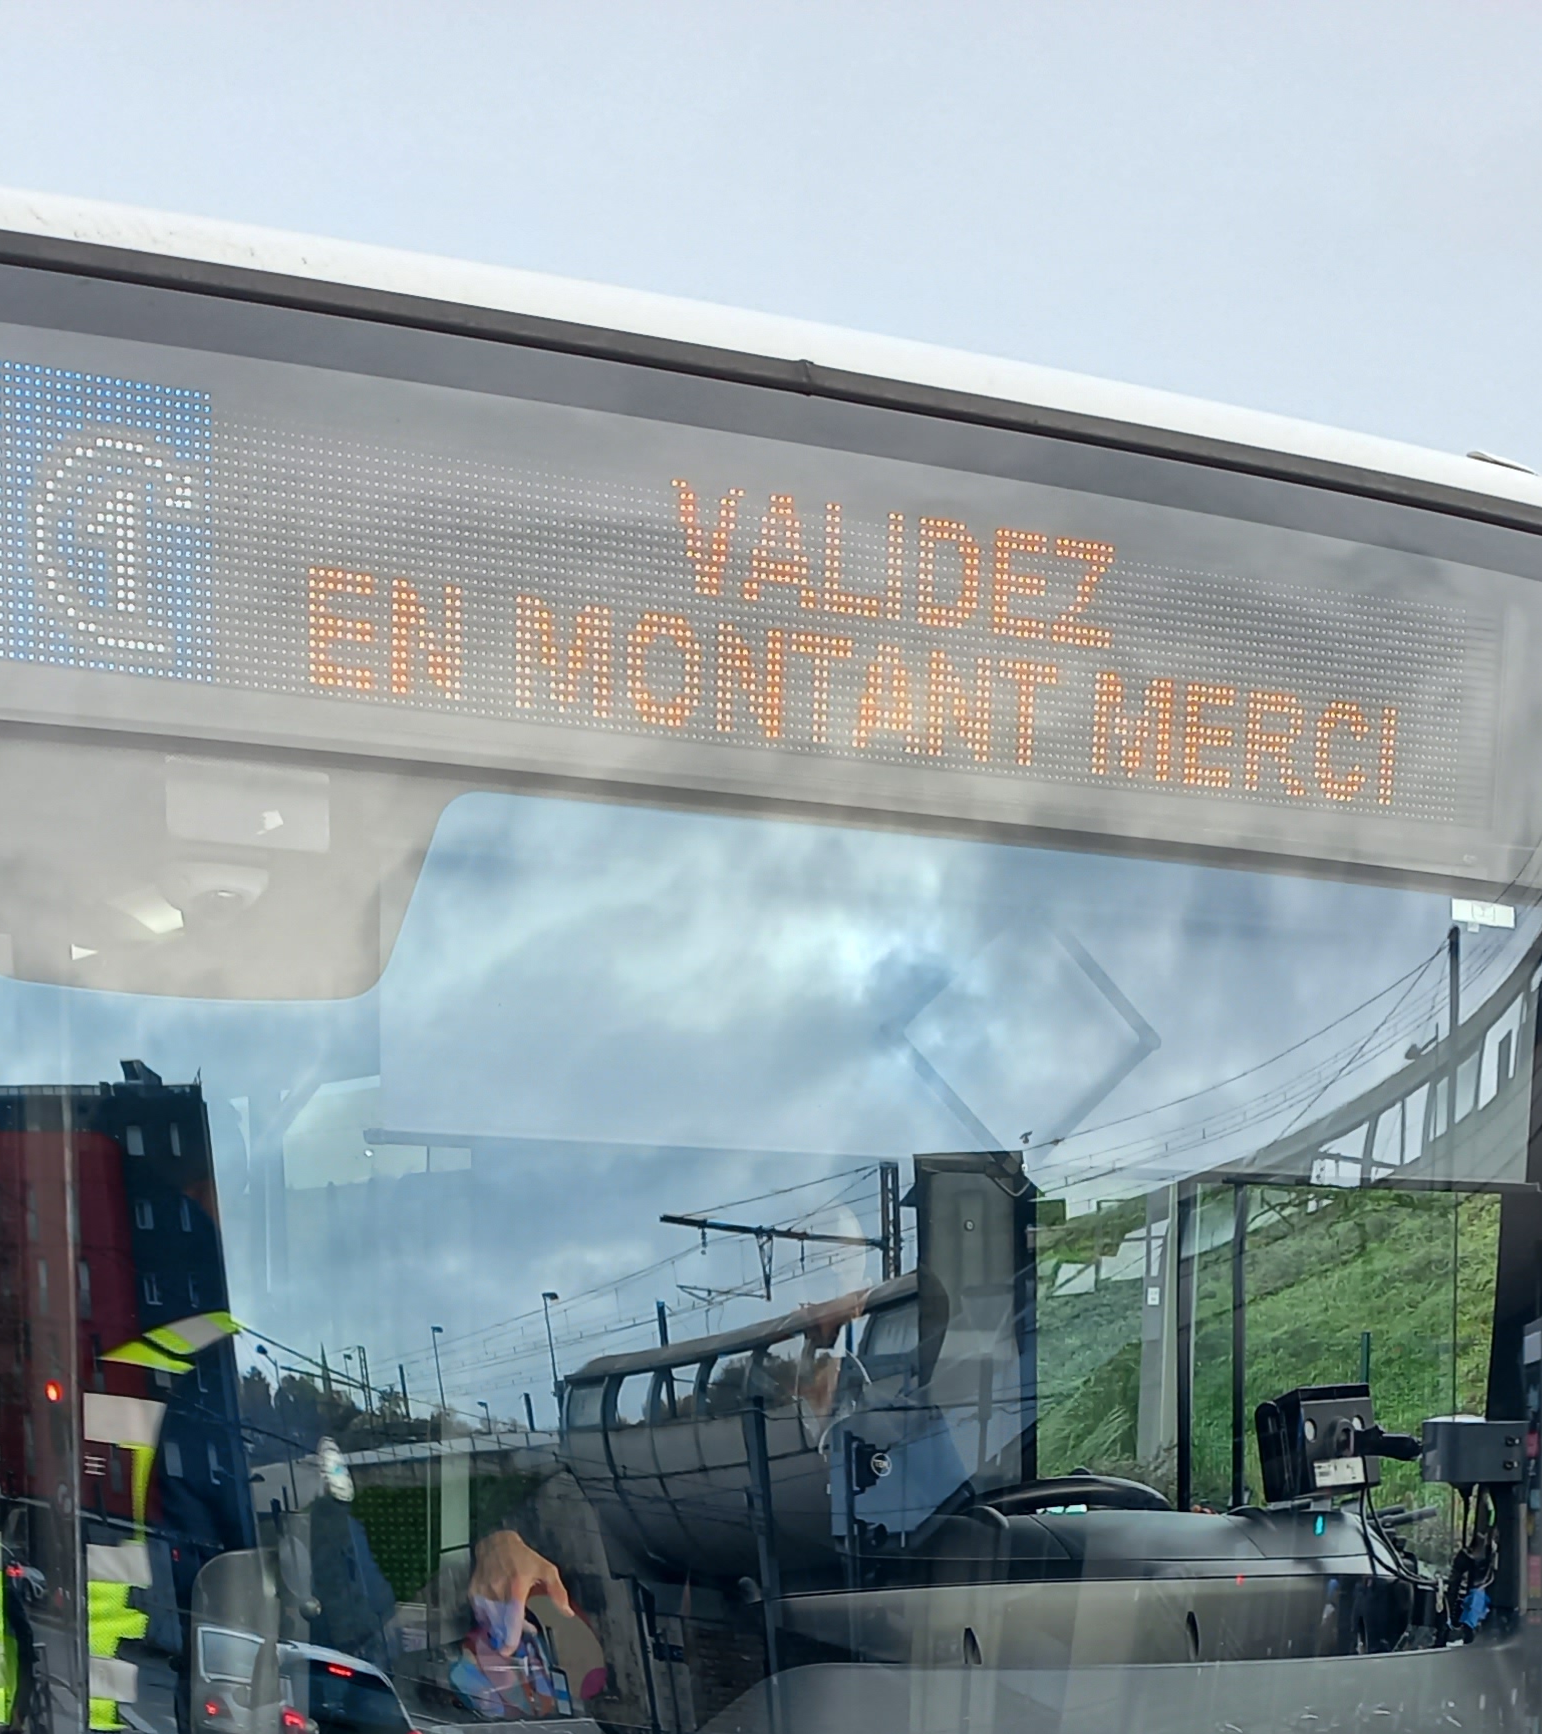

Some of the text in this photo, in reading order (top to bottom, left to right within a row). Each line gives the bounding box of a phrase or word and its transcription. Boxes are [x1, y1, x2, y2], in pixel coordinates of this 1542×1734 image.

[670, 478, 1114, 648] VALIDEZ
[308, 564, 1396, 805] EN MONTANT MERCI
